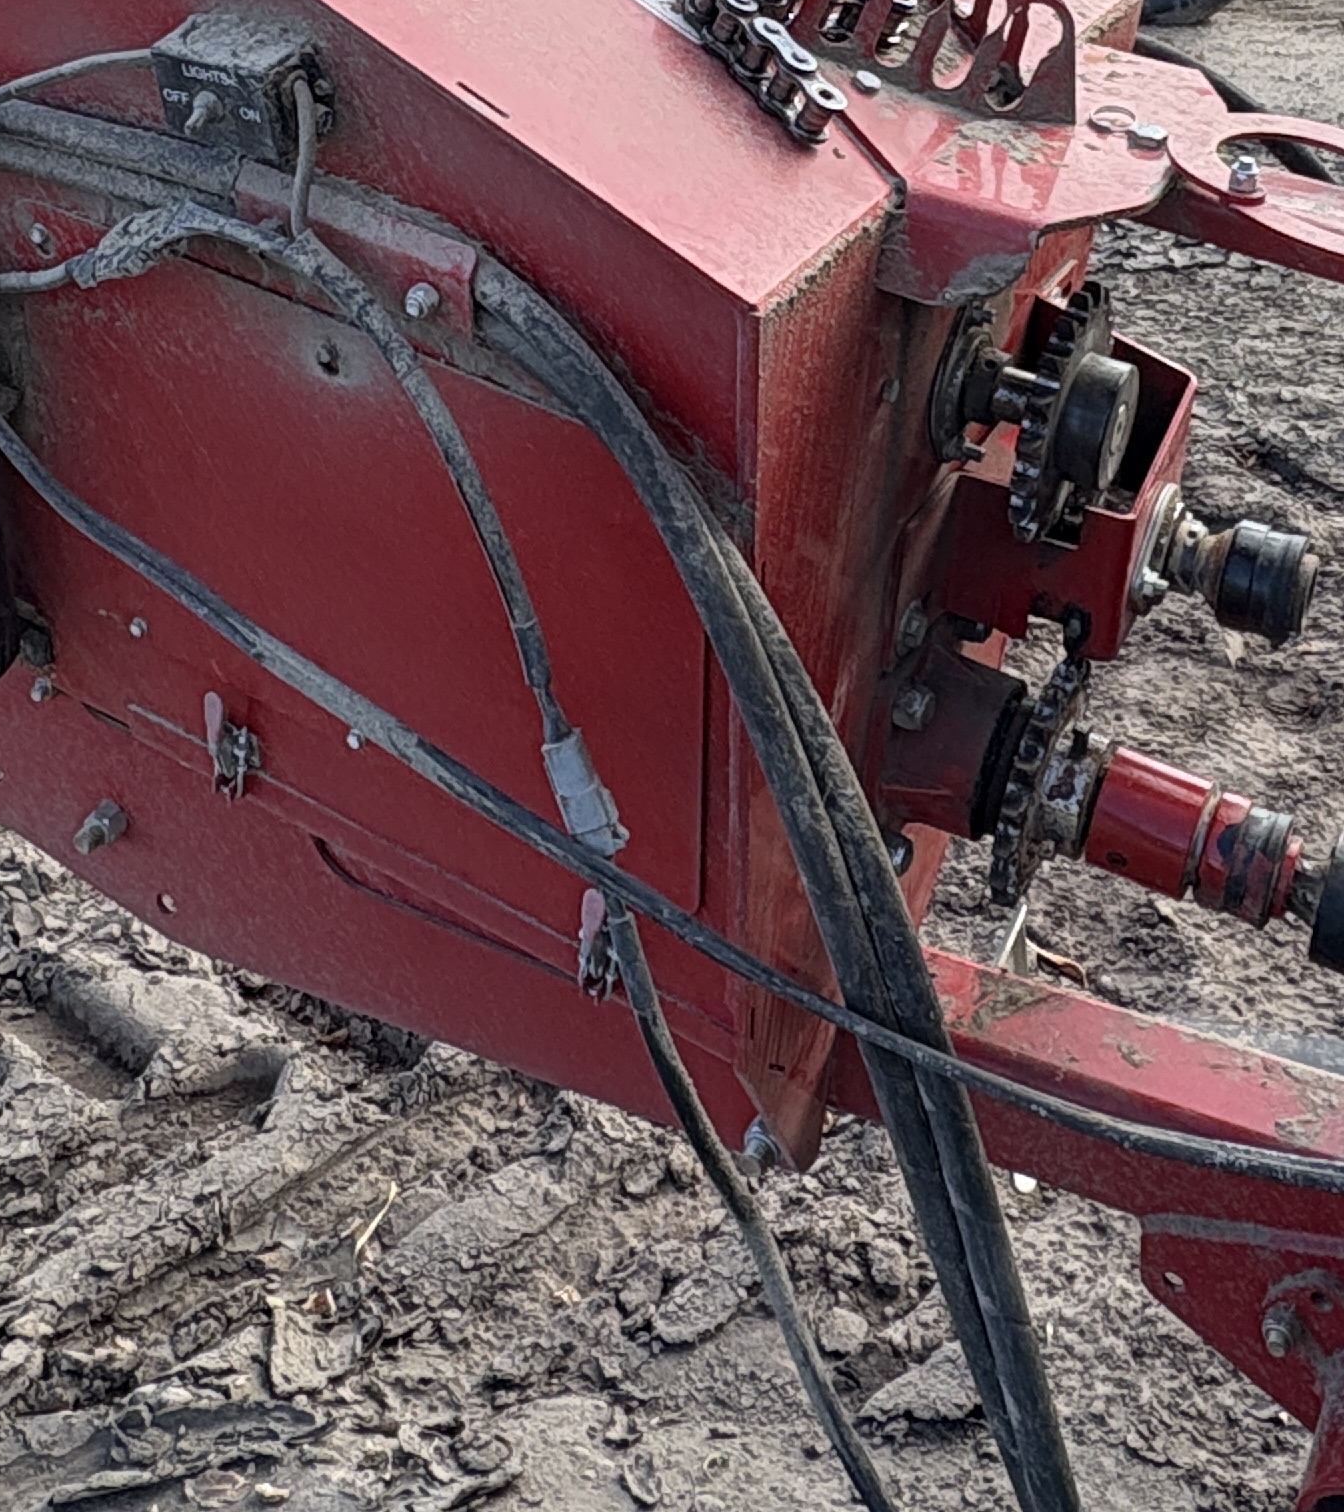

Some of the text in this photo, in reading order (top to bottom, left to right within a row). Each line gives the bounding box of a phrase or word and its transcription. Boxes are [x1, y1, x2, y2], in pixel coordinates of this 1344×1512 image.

[181, 63, 233, 86] LIGHTS
[163, 88, 190, 104] OFF
[239, 107, 261, 123] ON
